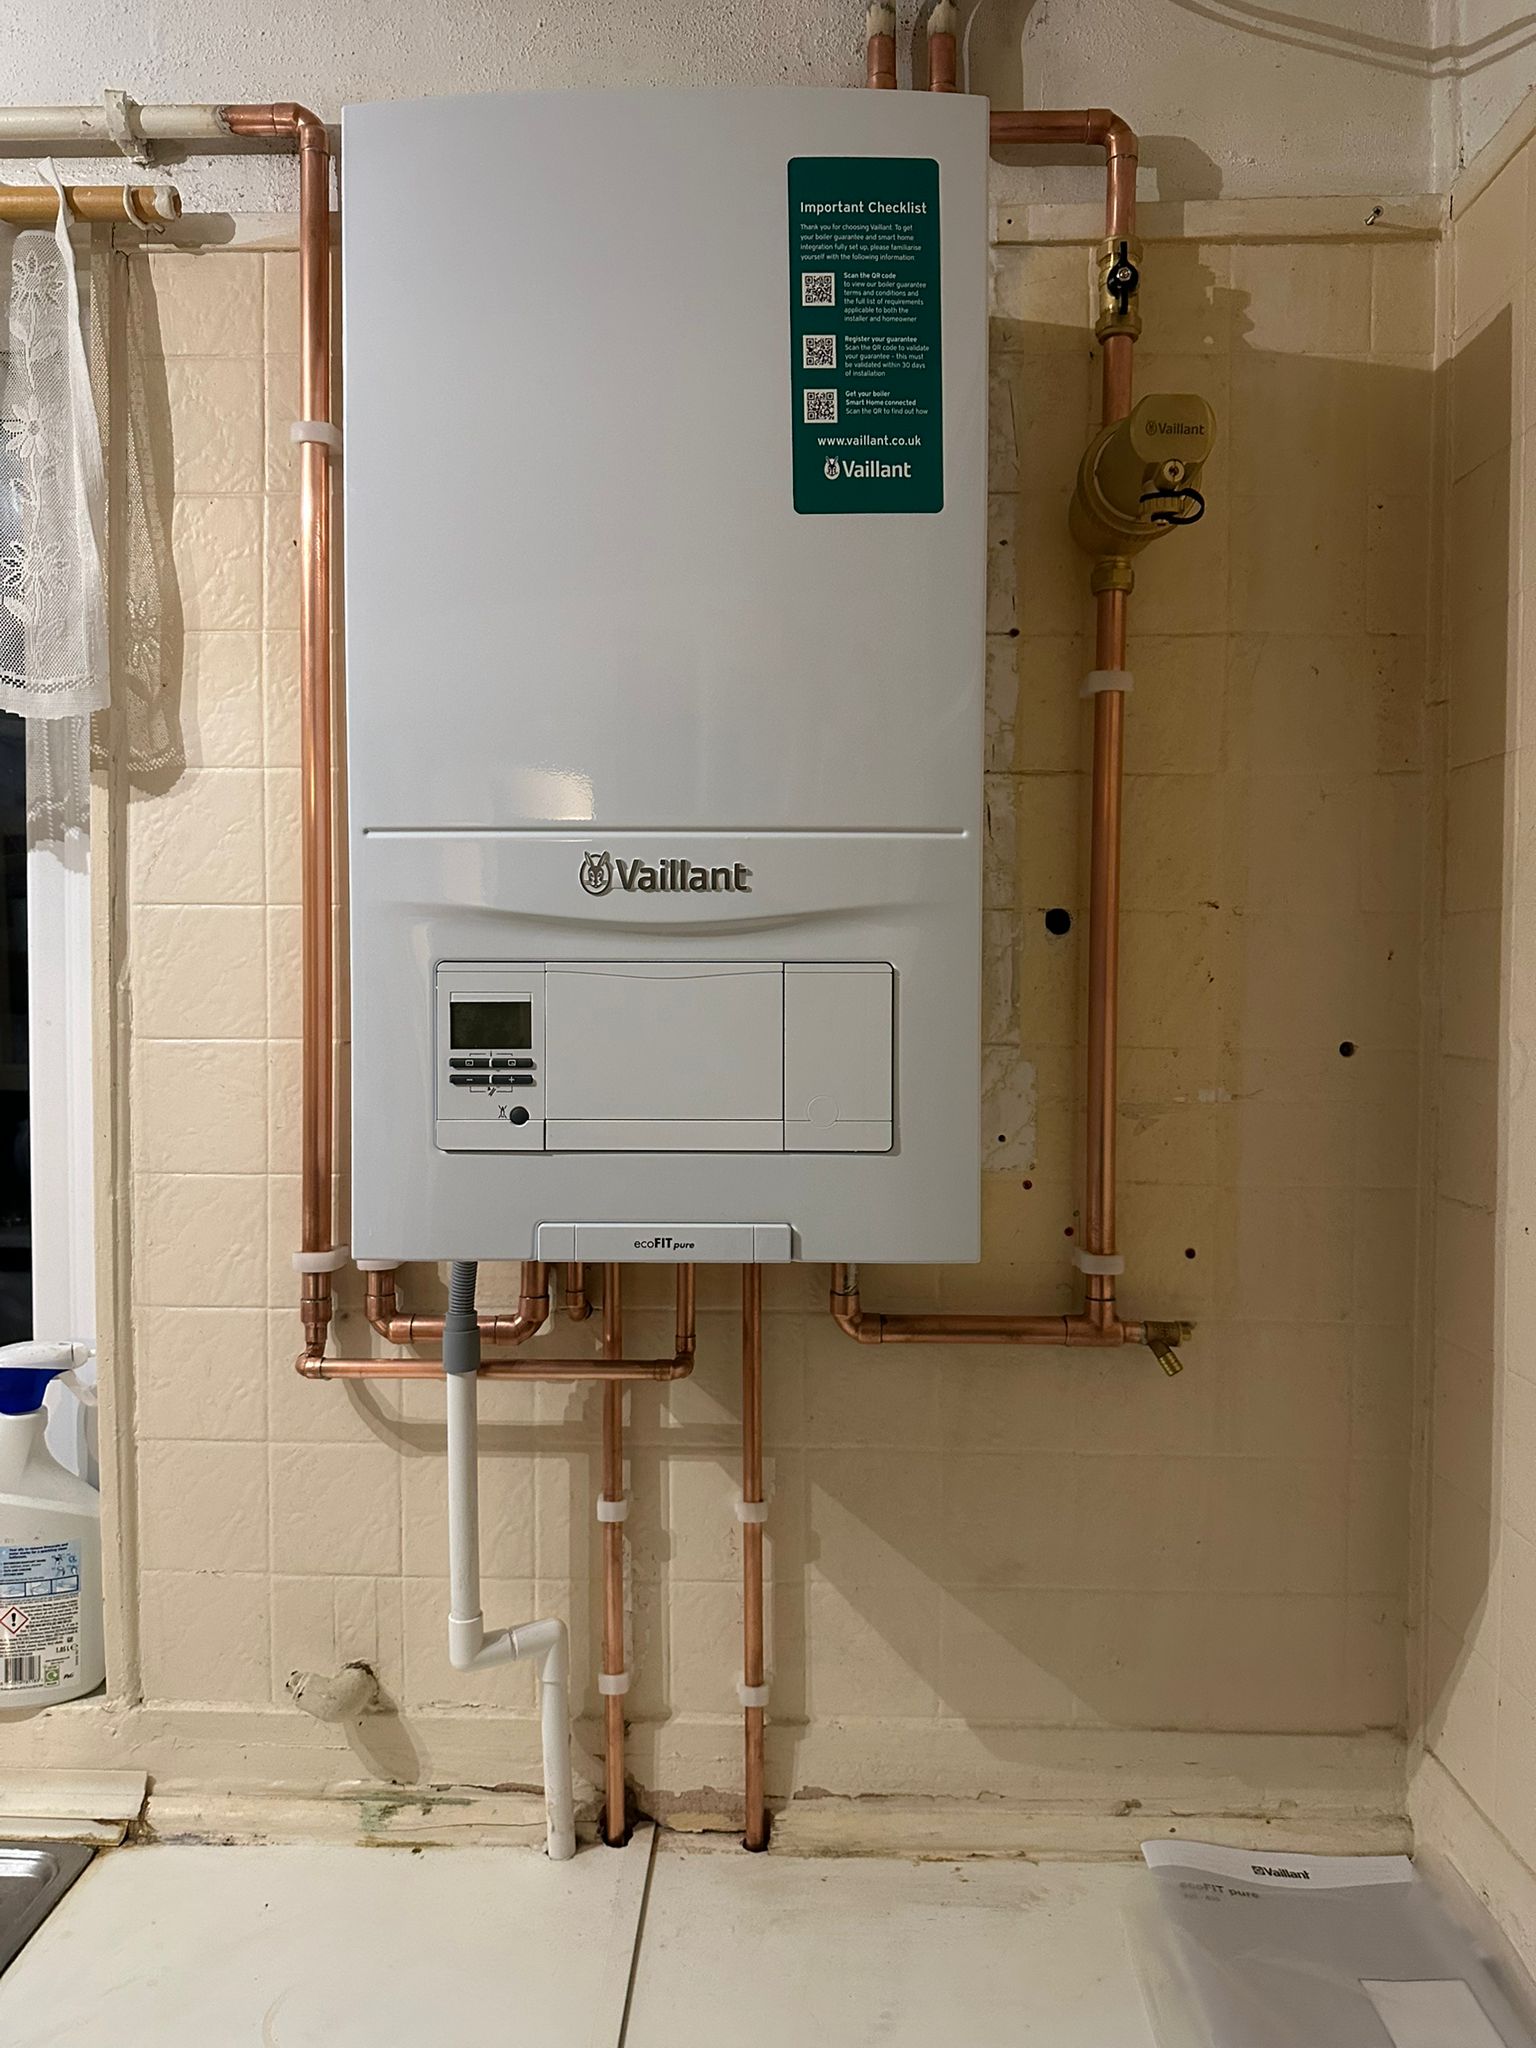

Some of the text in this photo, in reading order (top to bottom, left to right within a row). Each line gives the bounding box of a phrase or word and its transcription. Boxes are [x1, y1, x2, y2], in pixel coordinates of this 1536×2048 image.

[800, 201, 927, 215] Important Checklist
[842, 224, 869, 232] choosing
[834, 243, 847, 251] fully
[800, 253, 825, 261] yourself
[852, 254, 879, 262] following
[1158, 422, 1205, 436] Vaillant
[818, 435, 921, 446] www.vaillant.co.uk
[842, 460, 912, 478] Vaillant
[615, 858, 752, 893] Vaillant
[634, 1238, 695, 1250] ecoFIT pure
[1264, 1867, 1310, 1880] Vaillant
[1228, 1888, 1259, 1898] pure
